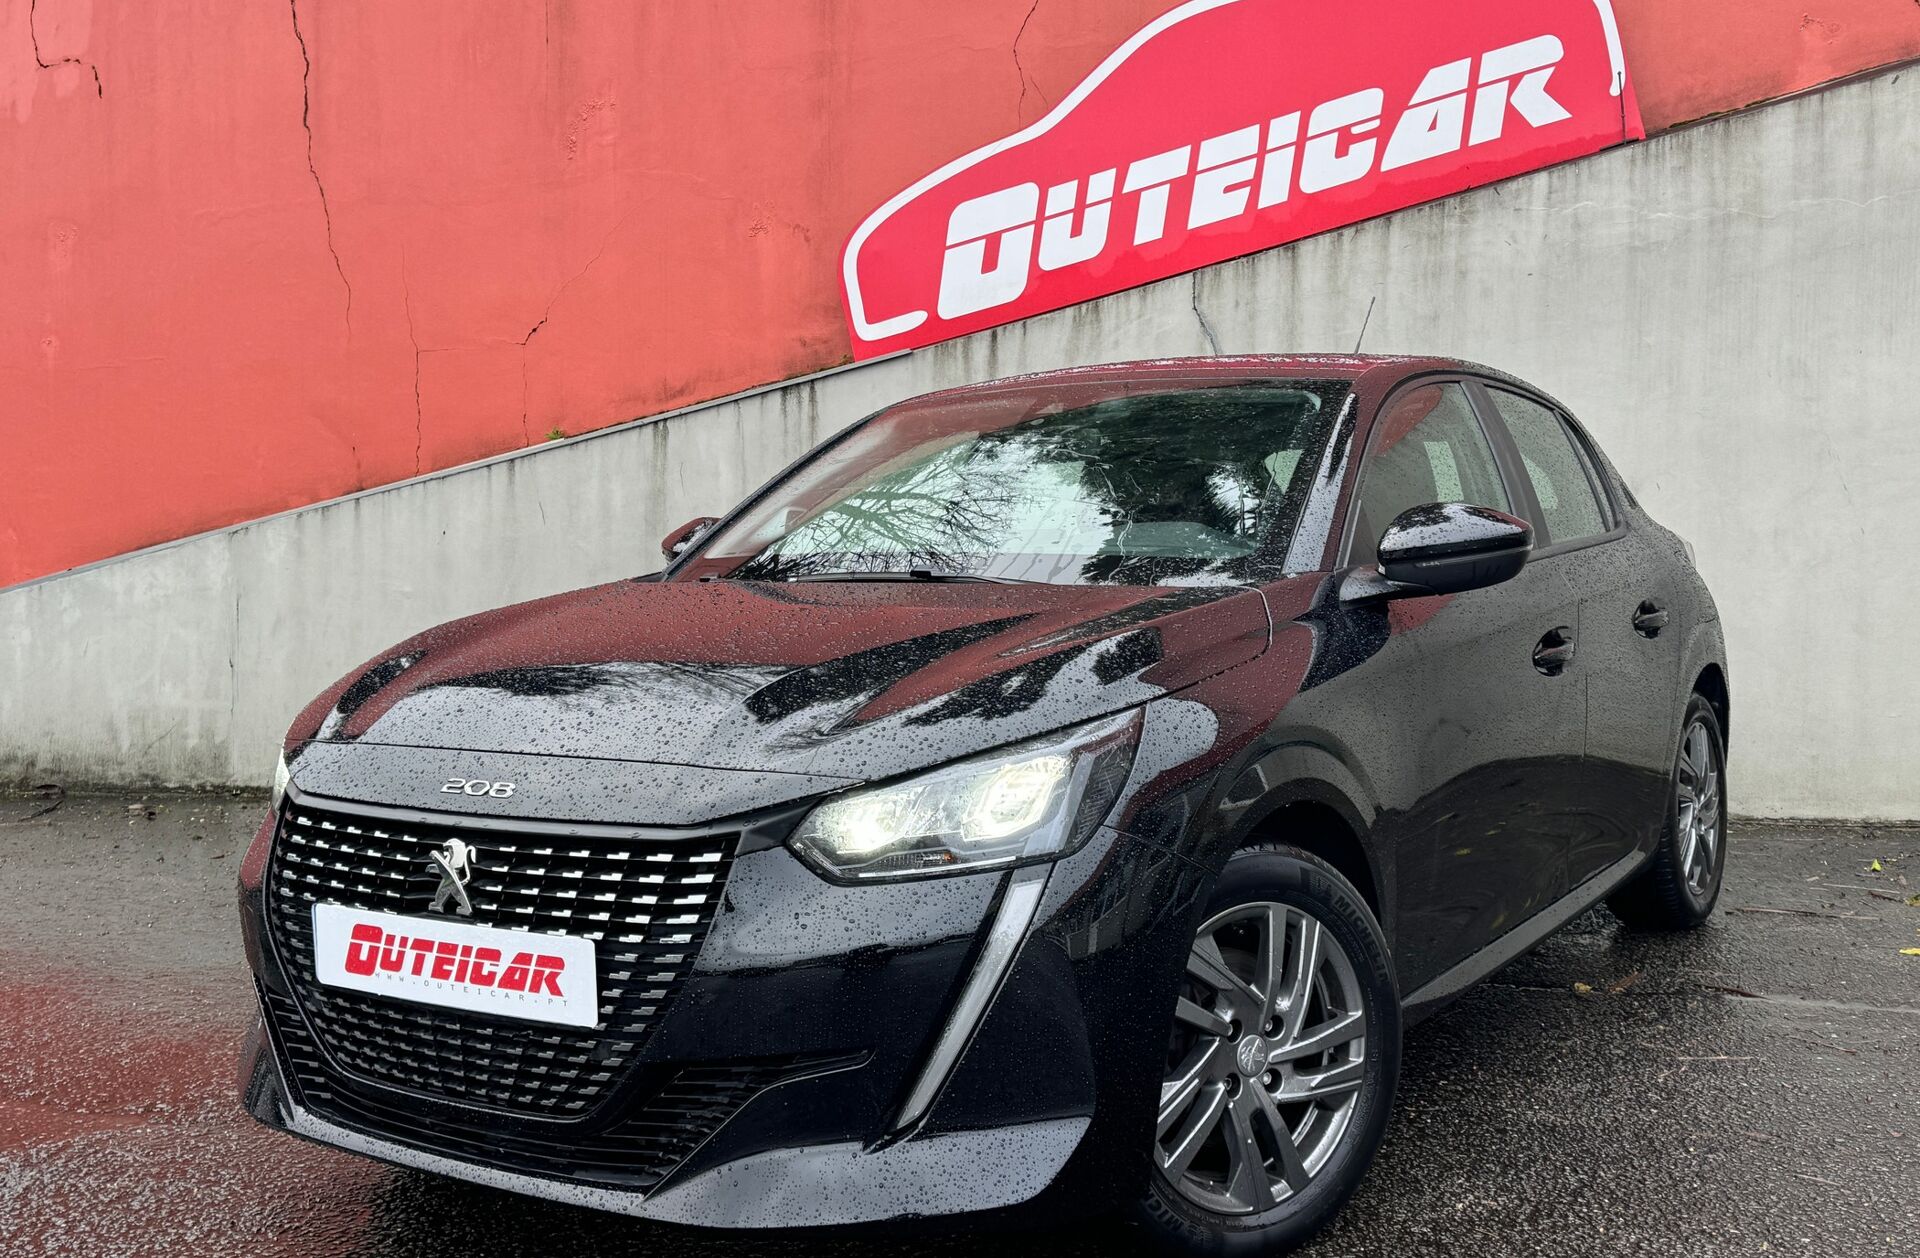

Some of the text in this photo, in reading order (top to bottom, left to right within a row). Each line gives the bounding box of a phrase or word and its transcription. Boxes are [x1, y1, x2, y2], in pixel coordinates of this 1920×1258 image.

[937, 34, 1572, 320] OUTEICAR
[440, 778, 516, 799] 208
[345, 923, 565, 997] OUTEICAR
